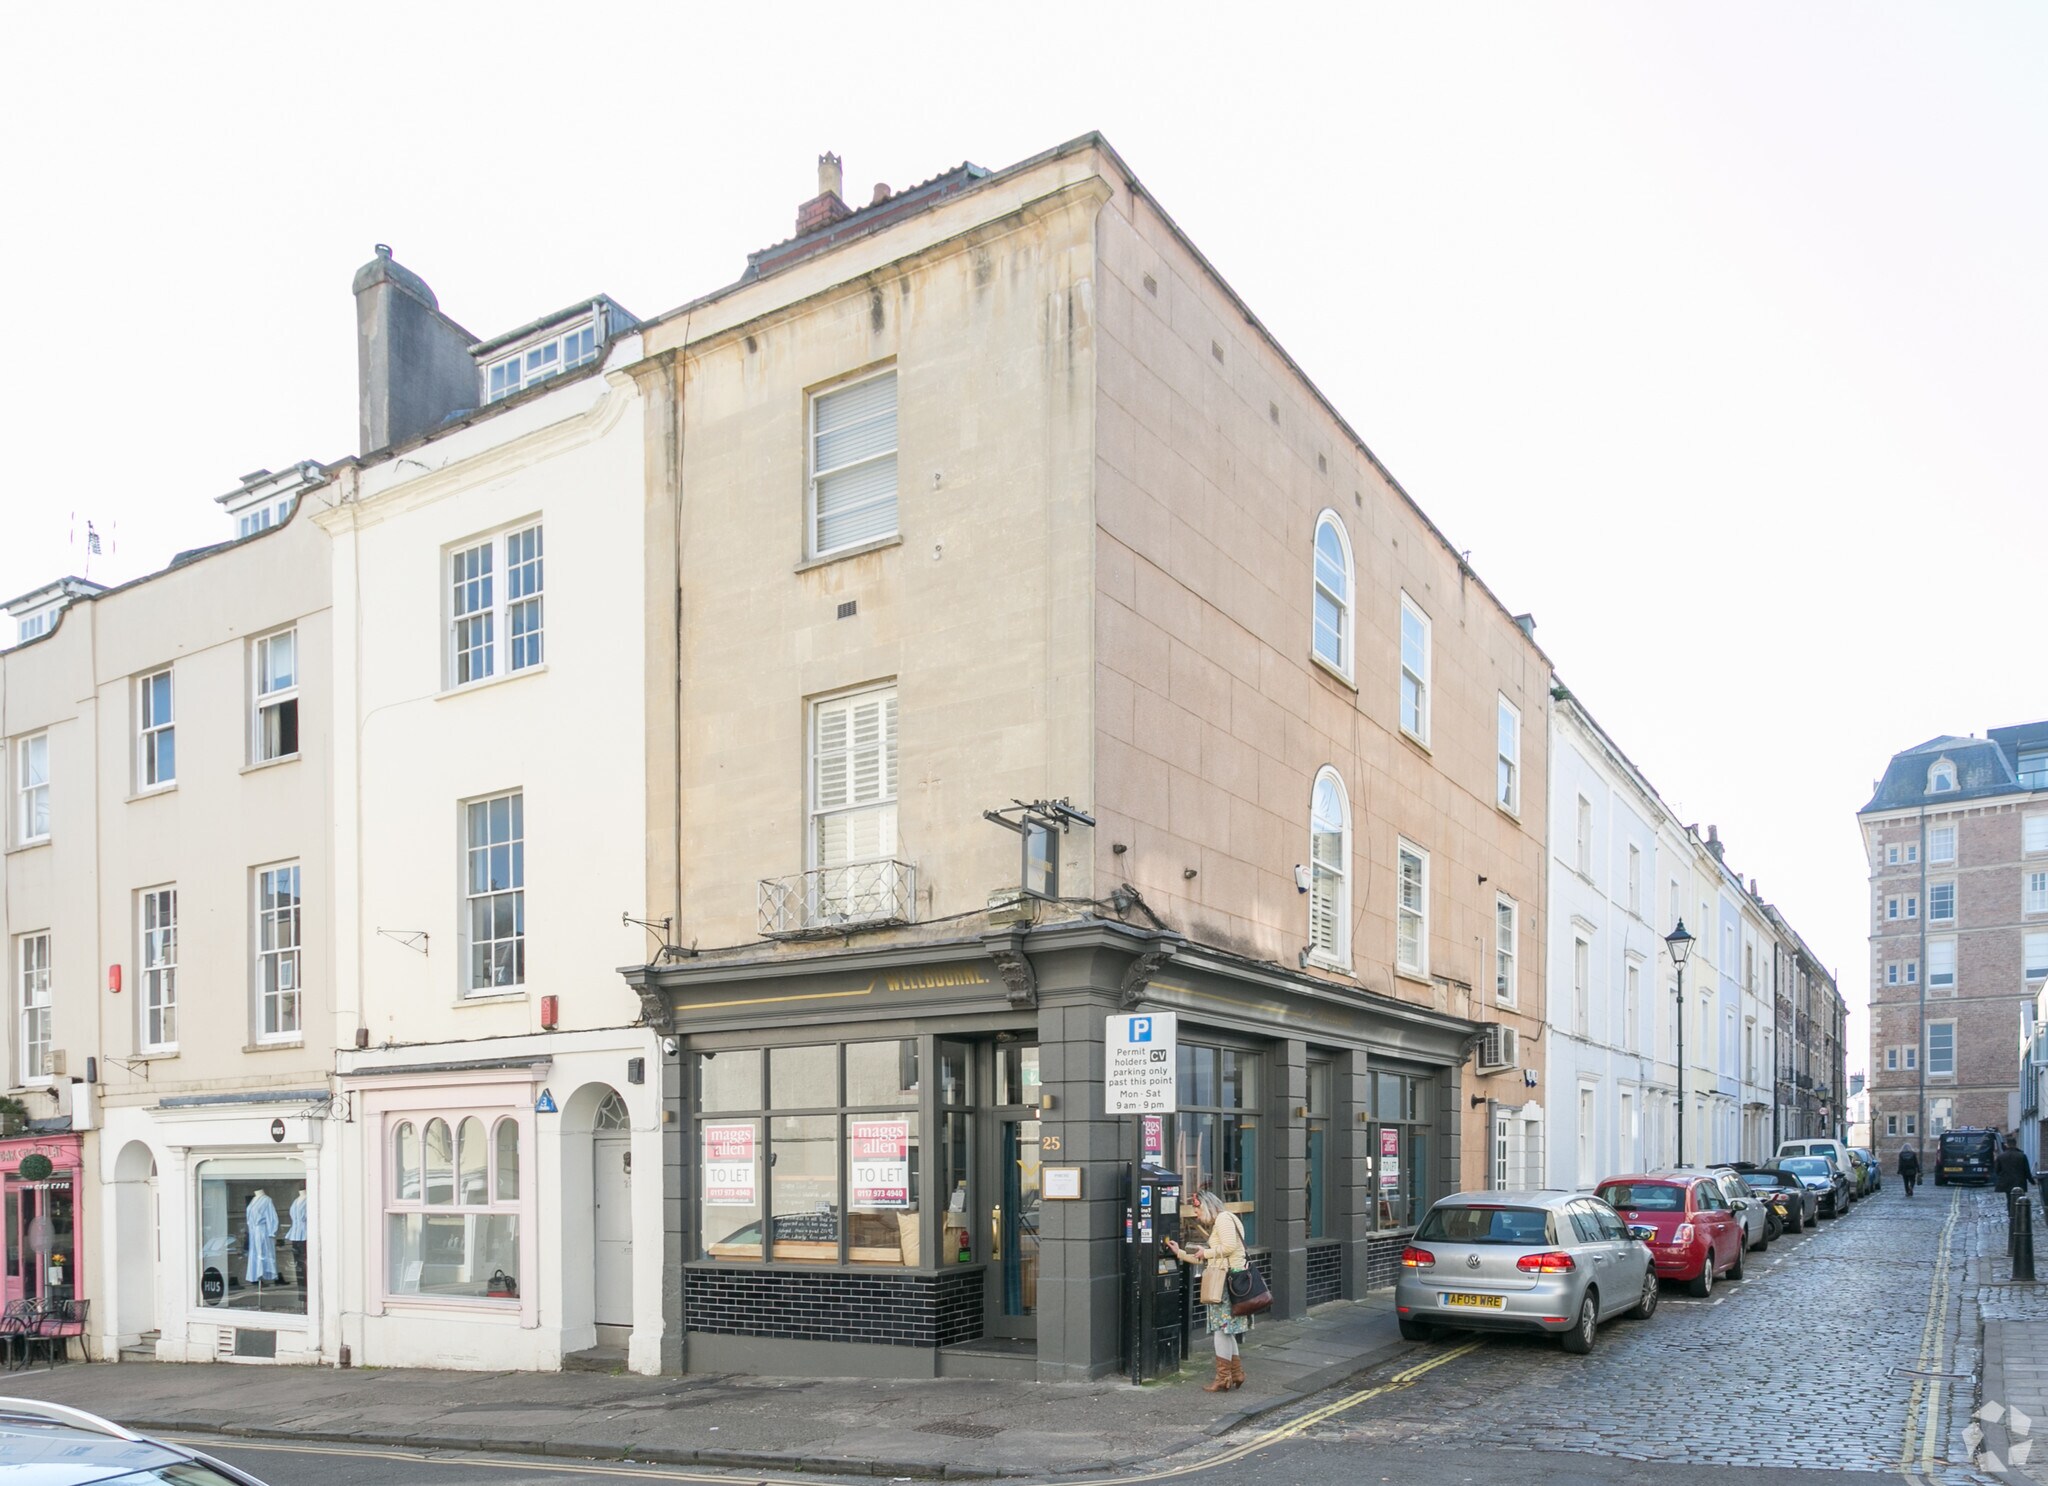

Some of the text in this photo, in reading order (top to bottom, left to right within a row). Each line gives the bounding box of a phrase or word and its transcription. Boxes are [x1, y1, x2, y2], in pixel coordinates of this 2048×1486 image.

[1133, 1019, 1150, 1041] P
[1116, 1048, 1166, 1061] Permit CV
[1114, 1058, 1147, 1066] holders
[1113, 1067, 1168, 1077] parking only
[1108, 1077, 1173, 1087] past this point
[1120, 1090, 1139, 1098] Mon
[1145, 1089, 1161, 1097] Sat
[1116, 1101, 1122, 1109] 9
[1143, 1101, 1149, 1109] 9
[1150, 1102, 1165, 1110] pm
[711, 1130, 752, 1144] maggs
[858, 1126, 904, 1141] maggs
[715, 1141, 745, 1156] allen
[863, 1138, 897, 1154] allen
[1042, 1136, 1061, 1150] 25
[710, 1168, 750, 1182] TO LET
[857, 1167, 903, 1182] TO LET
[857, 1189, 904, 1197] 0117 973 4940
[204, 1281, 221, 1292] HUS
[1450, 1294, 1501, 1307] AF09 WRE
